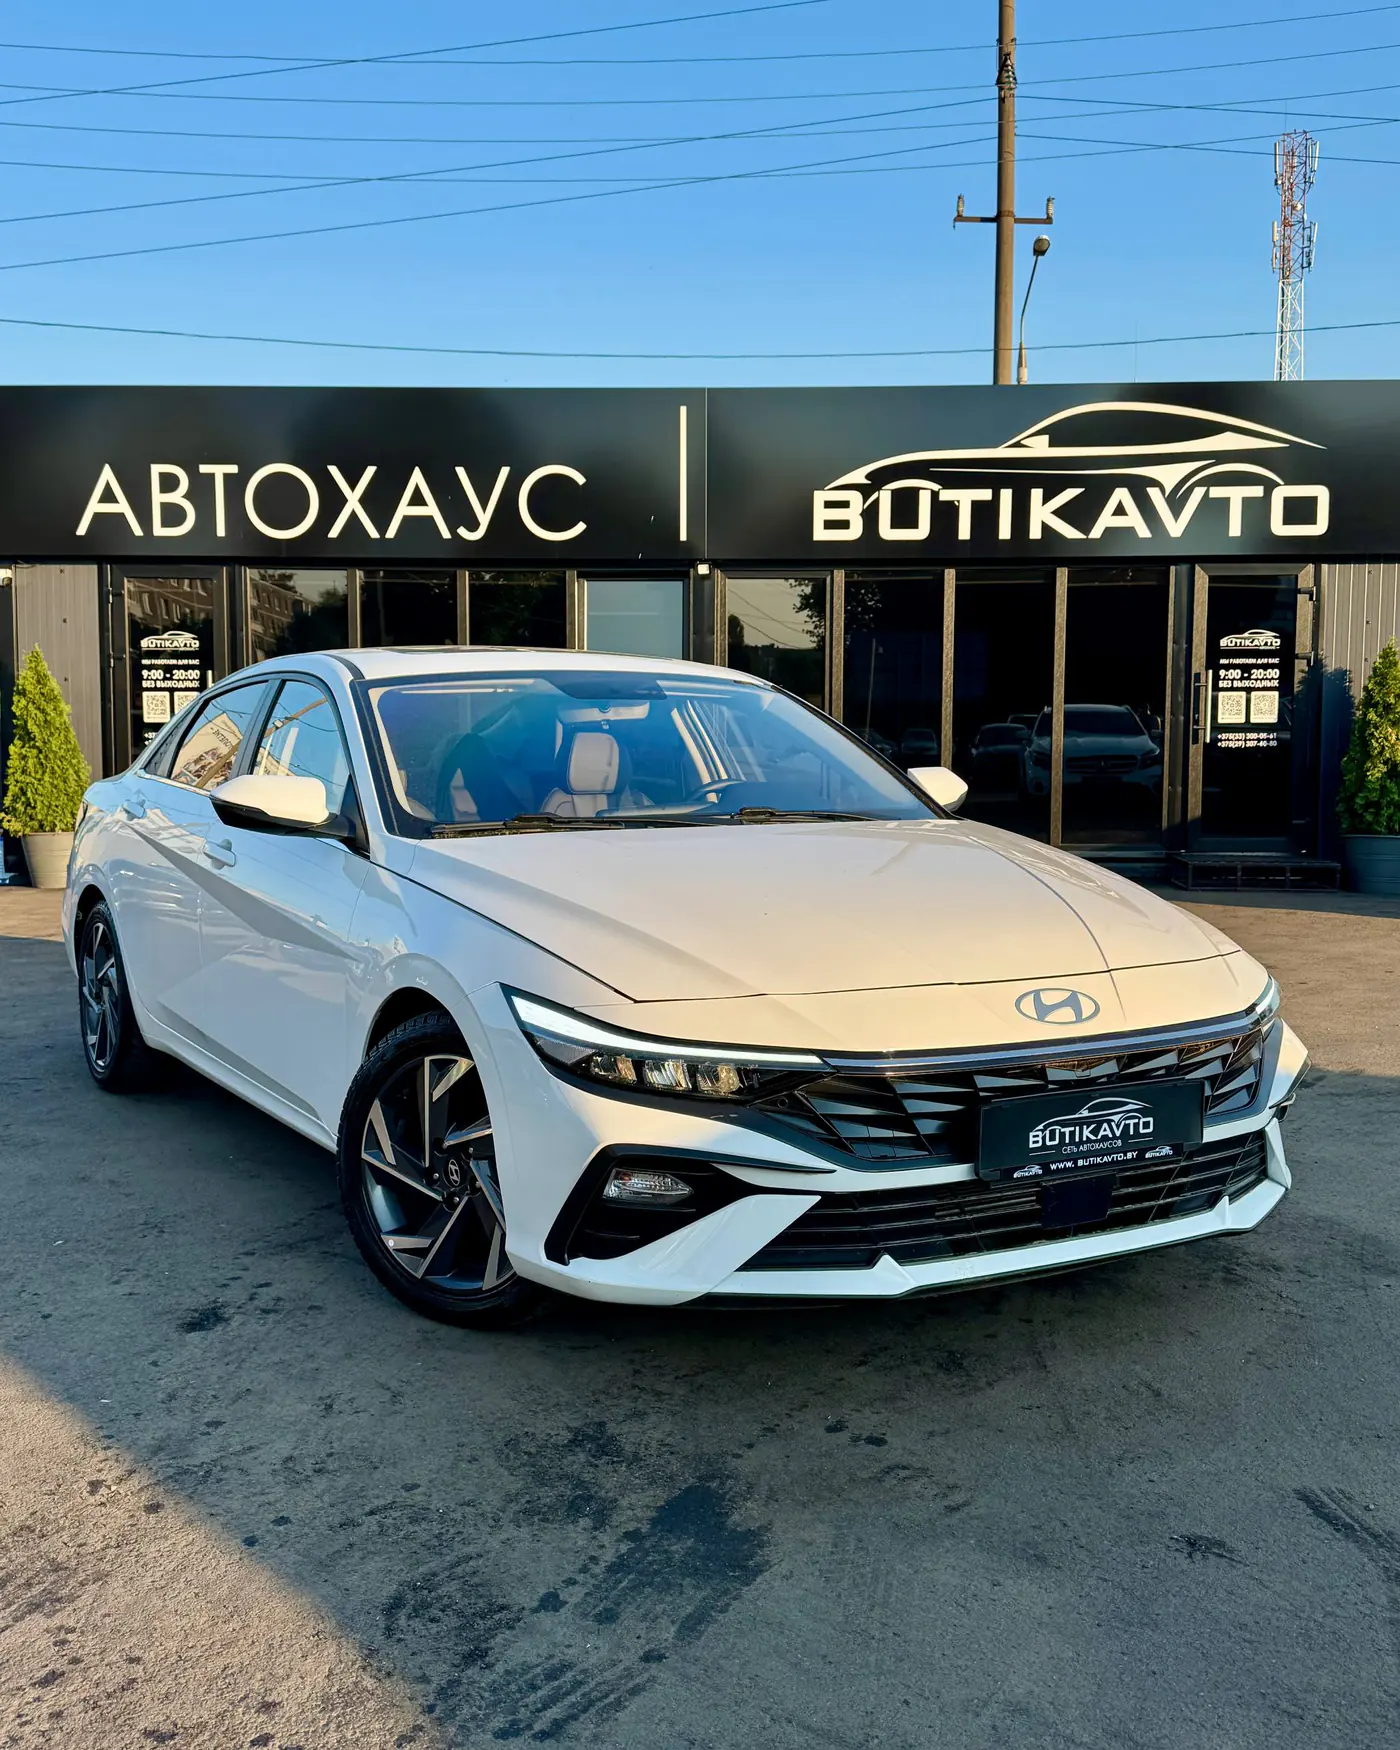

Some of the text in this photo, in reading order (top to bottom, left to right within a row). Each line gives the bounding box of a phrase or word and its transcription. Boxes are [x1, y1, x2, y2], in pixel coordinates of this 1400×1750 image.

[75, 462, 588, 541] АВТОХАУС
[812, 483, 1331, 542] BUTIKAVTO
[140, 639, 200, 648] BUTIKAVTO
[1219, 638, 1281, 647] BUTIKAVTO
[141, 669, 164, 680] 9:00
[172, 670, 200, 680] 20:00
[1218, 669, 1242, 680] 9:00
[1250, 668, 1280, 680] 20:00
[142, 680, 200, 688] БЕЗ ВЫХОДНЫХ
[1218, 680, 1280, 688] БЕЗ ВЫХОДНЫХ
[1028, 1116, 1154, 1148] BUTIKAVTO
[1061, 1140, 1122, 1154] СЕТЬ АВТОХАУСОВ
[1049, 1151, 1139, 1171] WWW. BUTIKAVTO.BY
